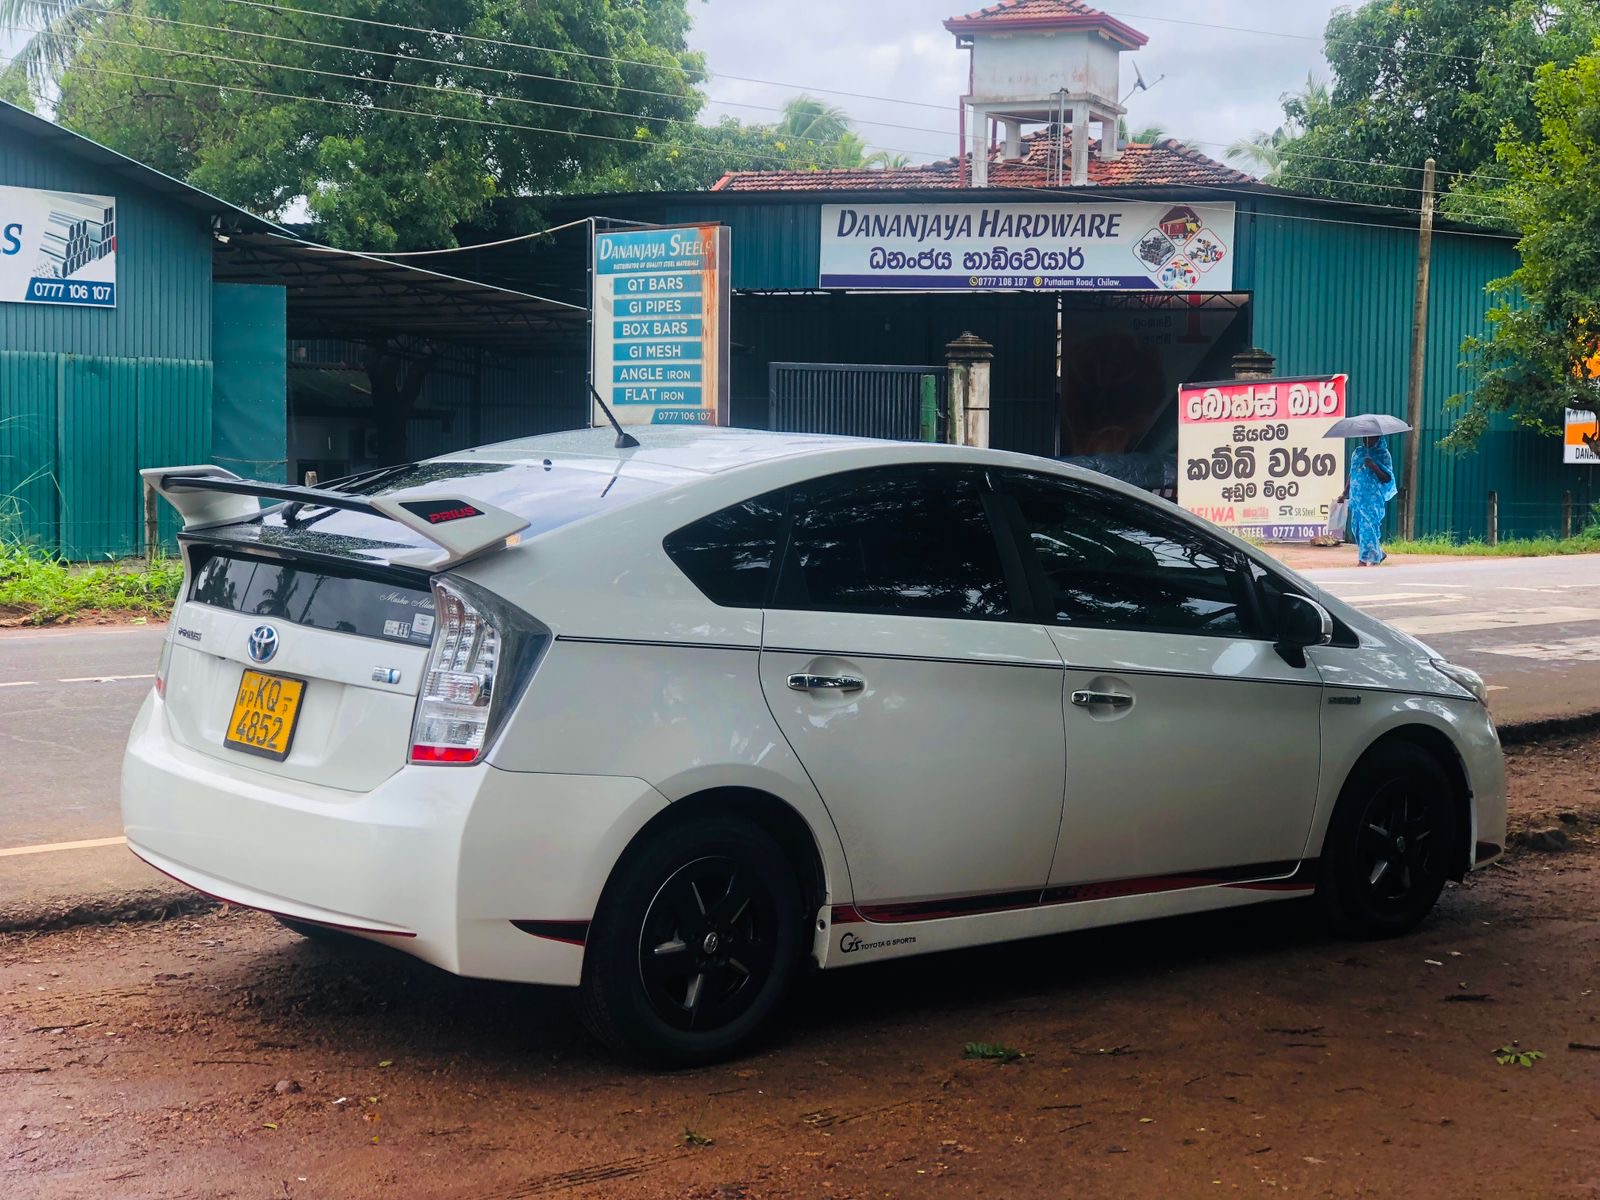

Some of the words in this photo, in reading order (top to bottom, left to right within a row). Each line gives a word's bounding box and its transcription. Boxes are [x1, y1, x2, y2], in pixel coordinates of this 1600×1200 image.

[837, 209, 972, 242] DANANJAYA
[978, 209, 1122, 239] HARDWARE
[0, 223, 23, 255] S
[600, 238, 665, 260] DANANJAYA
[869, 246, 953, 270] ධනංජය
[963, 246, 1085, 271] හාඩ්වෙයාර්
[627, 278, 645, 292] QT
[649, 277, 684, 291] BARS
[978, 277, 996, 287] 0777
[1014, 277, 1028, 287] 107
[1044, 277, 1074, 287] Puttalam
[1076, 277, 1095, 288] Road,
[1097, 277, 1122, 287] Chilaw.
[34, 282, 65, 297] 0777
[69, 284, 88, 299] 106
[93, 286, 111, 300] 107
[629, 301, 642, 314] GI
[646, 300, 681, 313] PIPES
[622, 323, 649, 336] BOX
[653, 322, 688, 335] BARS
[629, 345, 642, 358] GI
[646, 344, 681, 358] MESH
[620, 367, 663, 380] ANGLE
[667, 370, 691, 380] IRON
[625, 388, 657, 401] FLAT
[661, 391, 685, 401] IRON
[1187, 386, 1278, 420] බොක්ස්
[1288, 382, 1339, 416] බාර්
[658, 412, 679, 421] 0777
[681, 412, 695, 421] 106
[697, 412, 712, 421] 107
[1232, 423, 1289, 443] සියළුම
[1186, 446, 1256, 481] කම්බි
[1268, 447, 1337, 478] වර්ග
[1263, 480, 1299, 500] මිලට
[429, 506, 477, 523] PRIUS
[1279, 505, 1293, 516] SR
[1241, 526, 1265, 538] STEEL
[1272, 526, 1295, 538] 0777
[1298, 526, 1314, 537] 106
[1317, 526, 1333, 537] 10
[236, 710, 284, 748] 4852
[860, 940, 885, 950] TOYOTA
[892, 937, 917, 946] SPORTS
